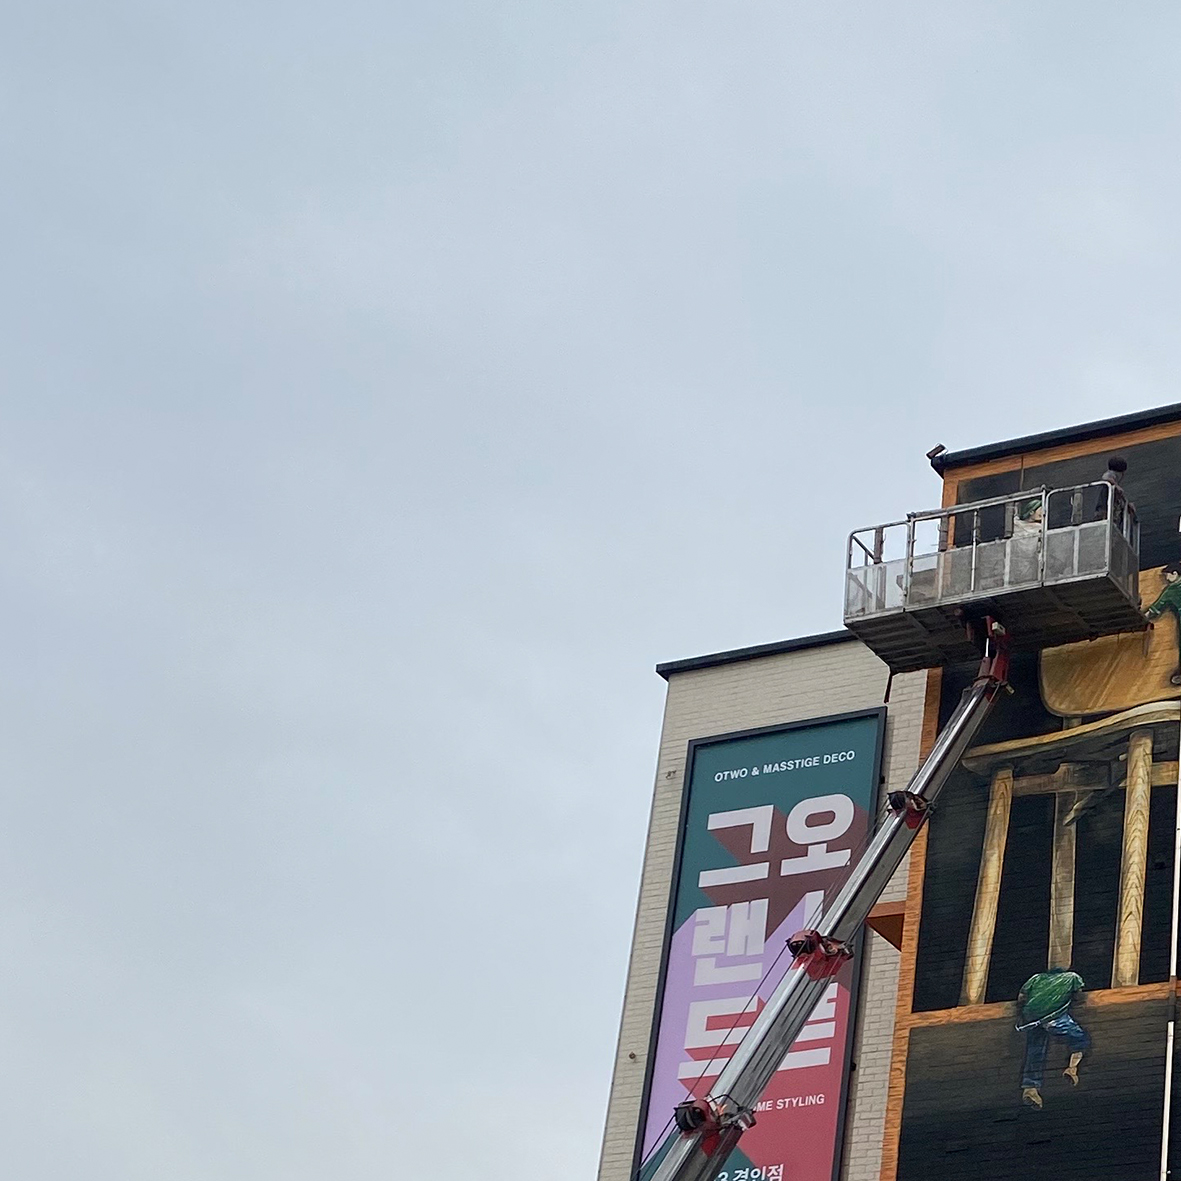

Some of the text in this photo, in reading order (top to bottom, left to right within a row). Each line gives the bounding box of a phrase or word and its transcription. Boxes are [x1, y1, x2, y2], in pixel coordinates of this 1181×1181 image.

[714, 750, 856, 782] OTWO & MASSTIGE DECO
[776, 1094, 825, 1110] STYLING
